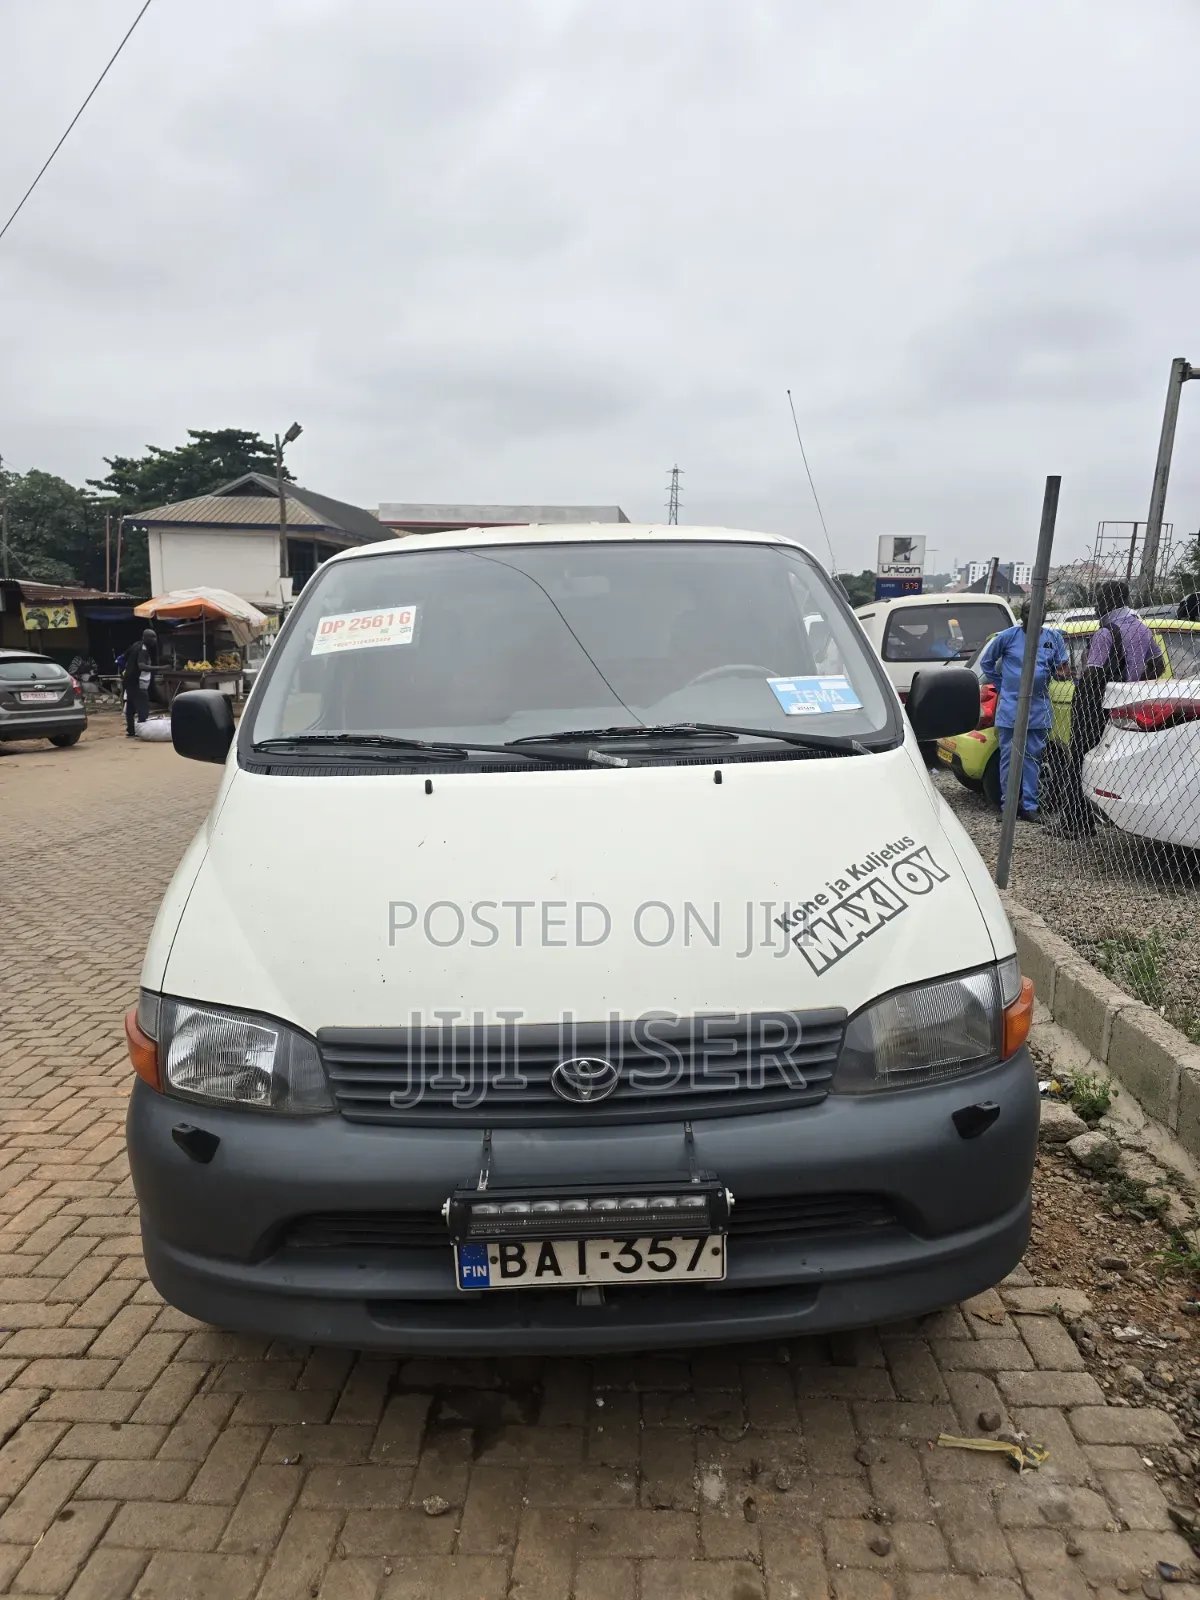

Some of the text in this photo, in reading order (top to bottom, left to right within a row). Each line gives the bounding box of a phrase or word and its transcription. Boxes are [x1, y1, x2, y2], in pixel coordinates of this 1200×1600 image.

[881, 565, 921, 574] Unicorn
[320, 611, 412, 635] DP 2561 G
[790, 689, 845, 703] TEMA
[773, 835, 916, 934] Kone ja Kuljetus
[791, 845, 951, 978] MAXI OY
[462, 1264, 488, 1278] FIN
